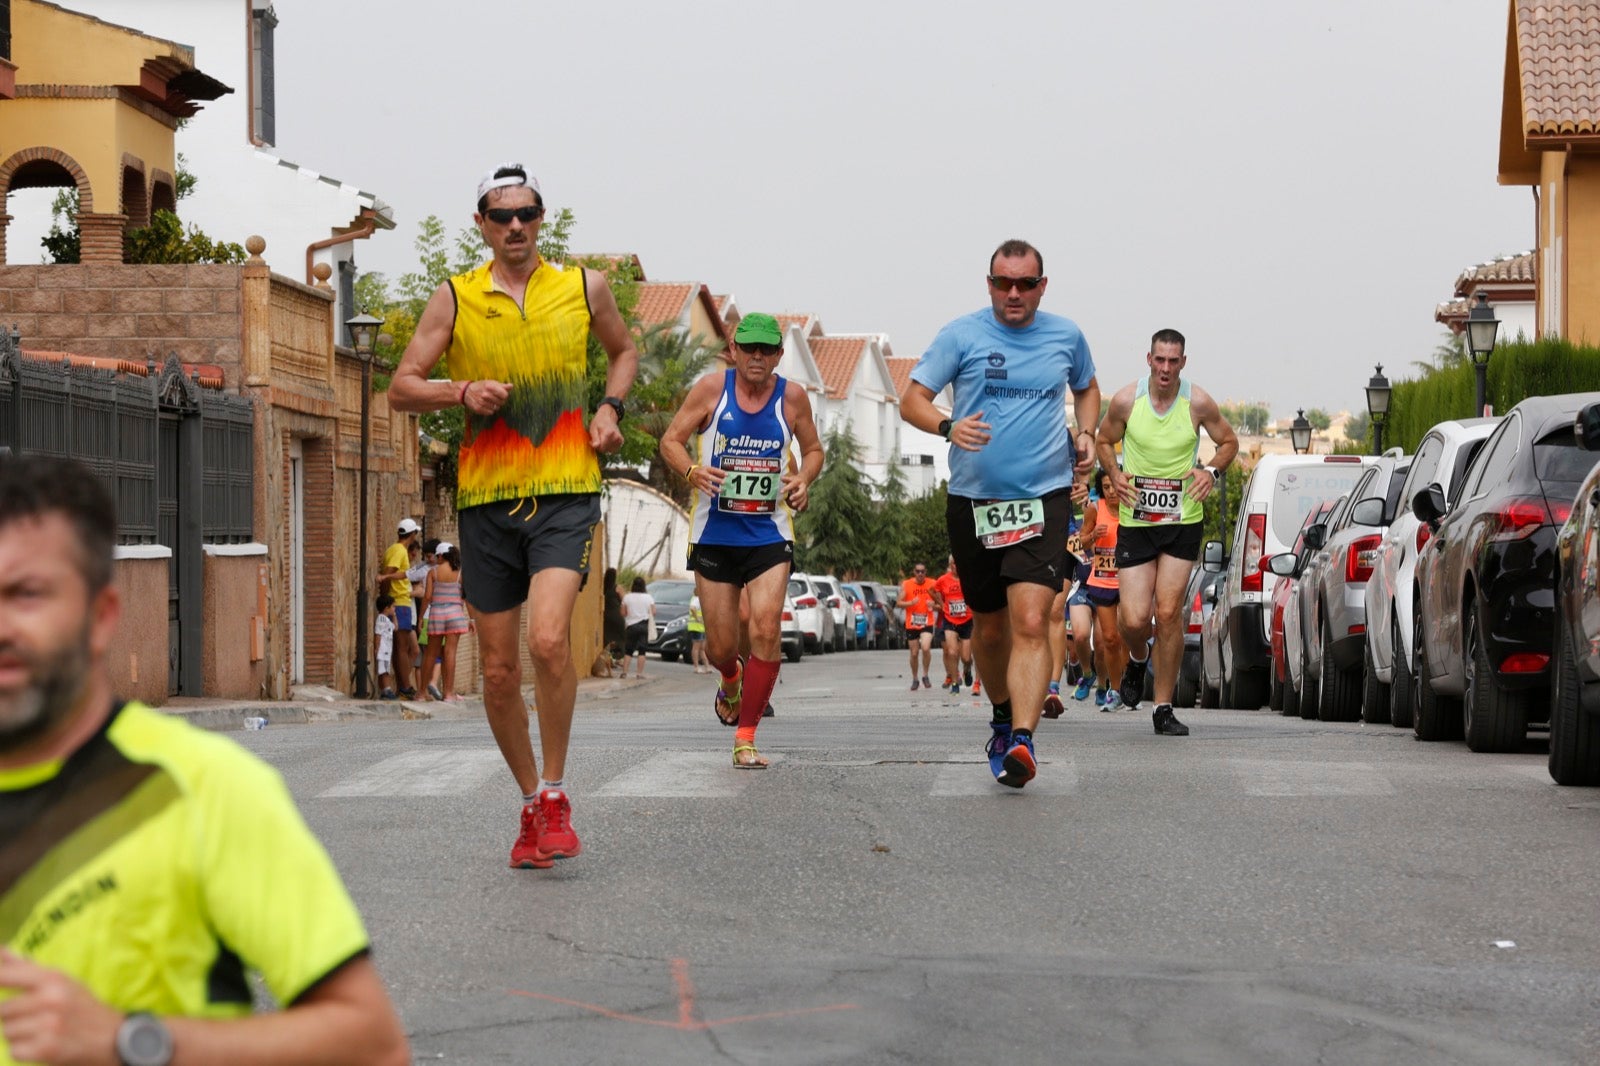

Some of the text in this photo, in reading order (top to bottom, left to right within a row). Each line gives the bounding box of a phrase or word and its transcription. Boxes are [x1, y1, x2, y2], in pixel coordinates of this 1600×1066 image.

[730, 435, 780, 451] olimpo
[732, 475, 772, 496] 179
[1140, 490, 1178, 508] 3003
[987, 503, 1033, 528] 645
